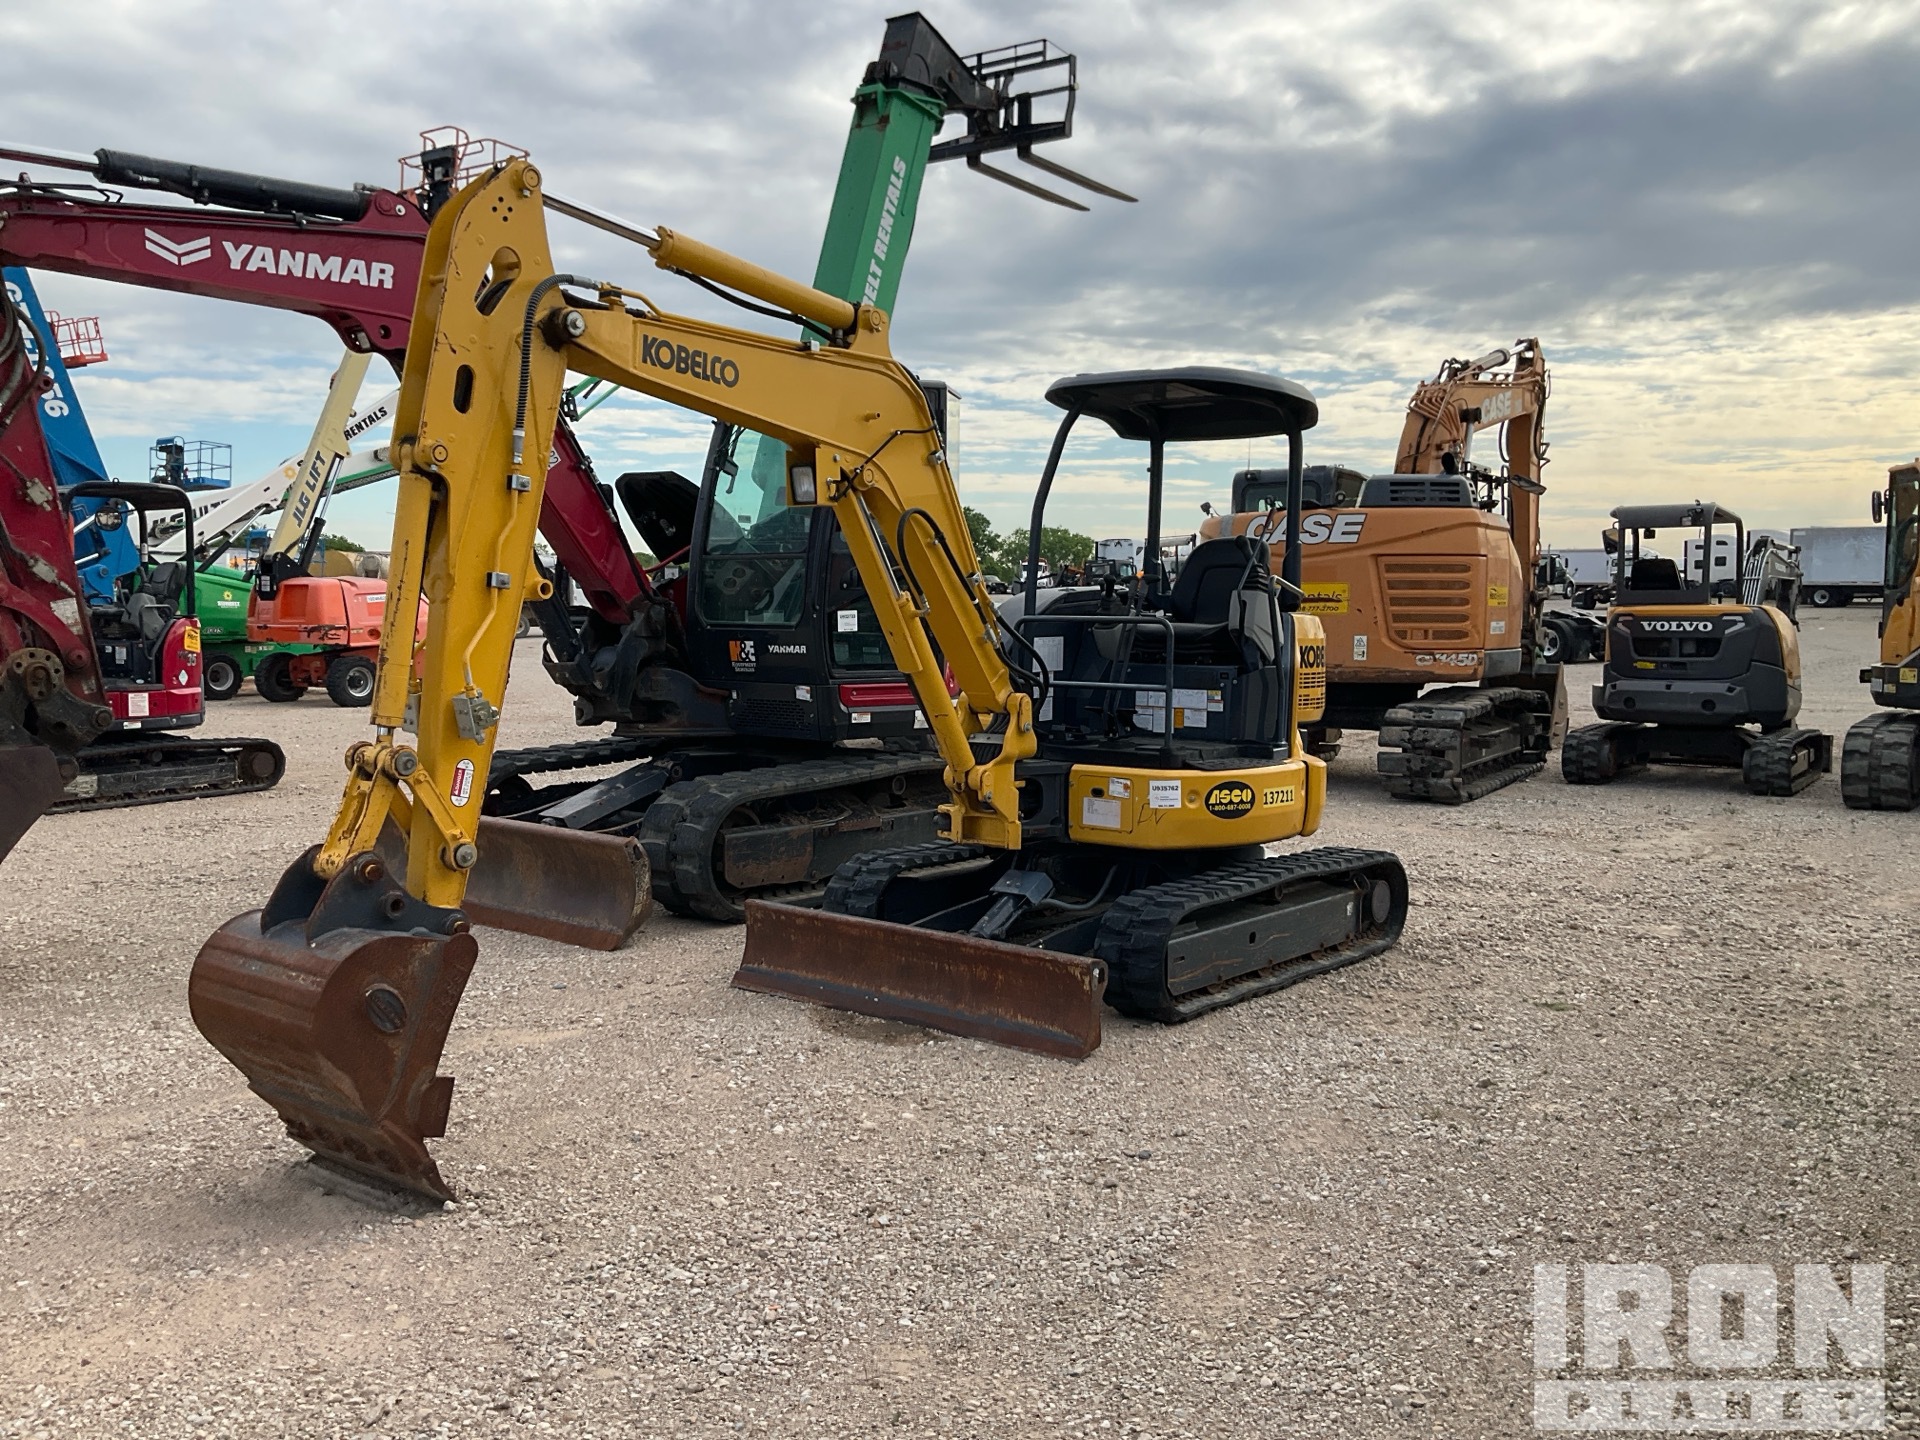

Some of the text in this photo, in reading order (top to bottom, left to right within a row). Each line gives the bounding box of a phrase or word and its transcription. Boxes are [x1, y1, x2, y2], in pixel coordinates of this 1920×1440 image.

[873, 155, 906, 262] RENTALS
[221, 240, 395, 289] YANMAR
[641, 333, 740, 388] KOBELCO
[343, 406, 388, 441] RENTALS
[1481, 389, 1512, 424] CASE
[292, 450, 326, 529] JLG LIFT
[1246, 512, 1368, 545] CASE
[1640, 621, 1713, 632] VOLVO
[767, 645, 807, 654] YANMAR
[1208, 788, 1253, 804] ASCO
[1263, 789, 1294, 805] 137211
